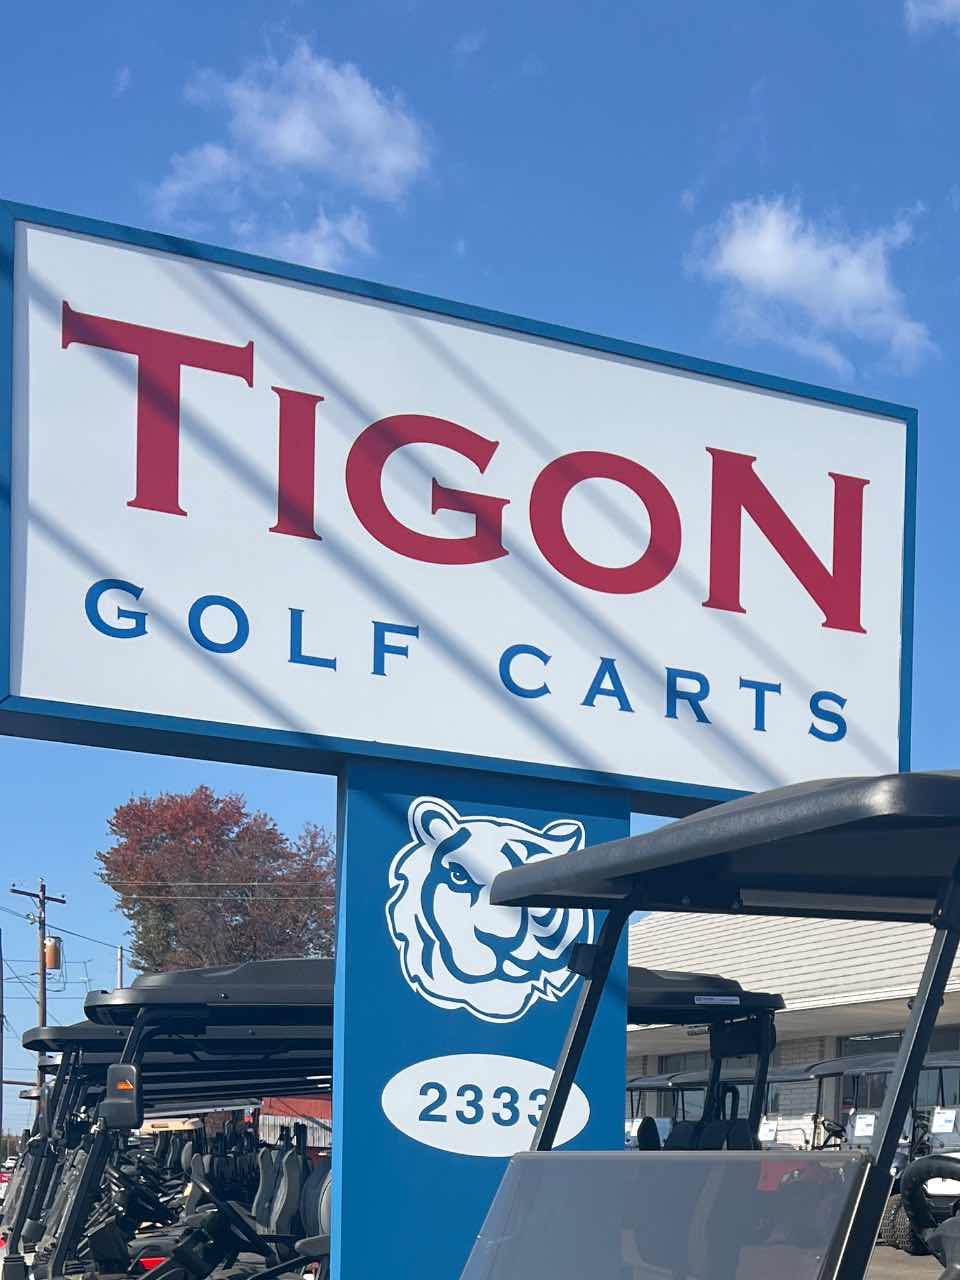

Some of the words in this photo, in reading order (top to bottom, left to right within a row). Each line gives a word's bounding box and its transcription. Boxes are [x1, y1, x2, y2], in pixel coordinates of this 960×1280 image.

[62, 300, 869, 633] TIGON
[84, 579, 420, 676] GOLF
[498, 644, 847, 742] CARTS
